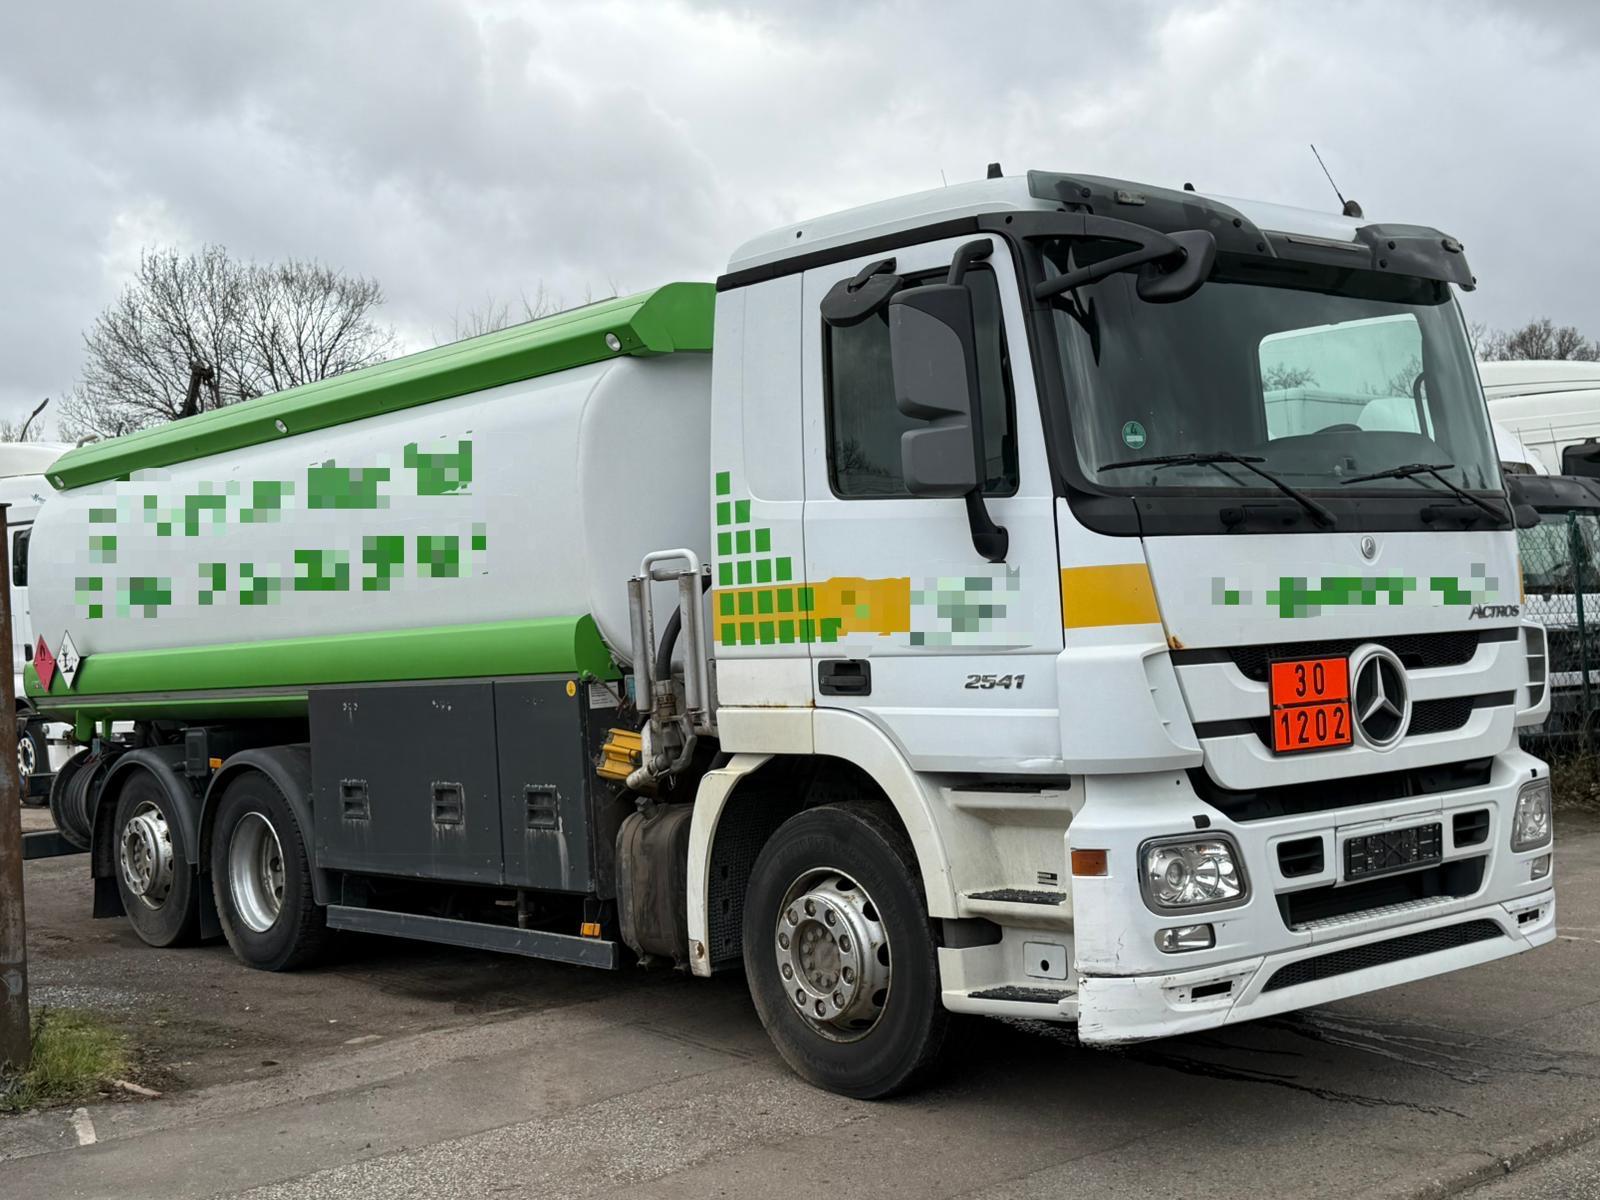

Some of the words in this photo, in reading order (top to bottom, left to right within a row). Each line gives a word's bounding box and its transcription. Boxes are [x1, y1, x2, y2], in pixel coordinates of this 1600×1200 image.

[1468, 604, 1520, 620] ACTROS
[964, 674, 1025, 689] 2541
[1295, 663, 1325, 697] 30
[1281, 706, 1346, 746] 1202
